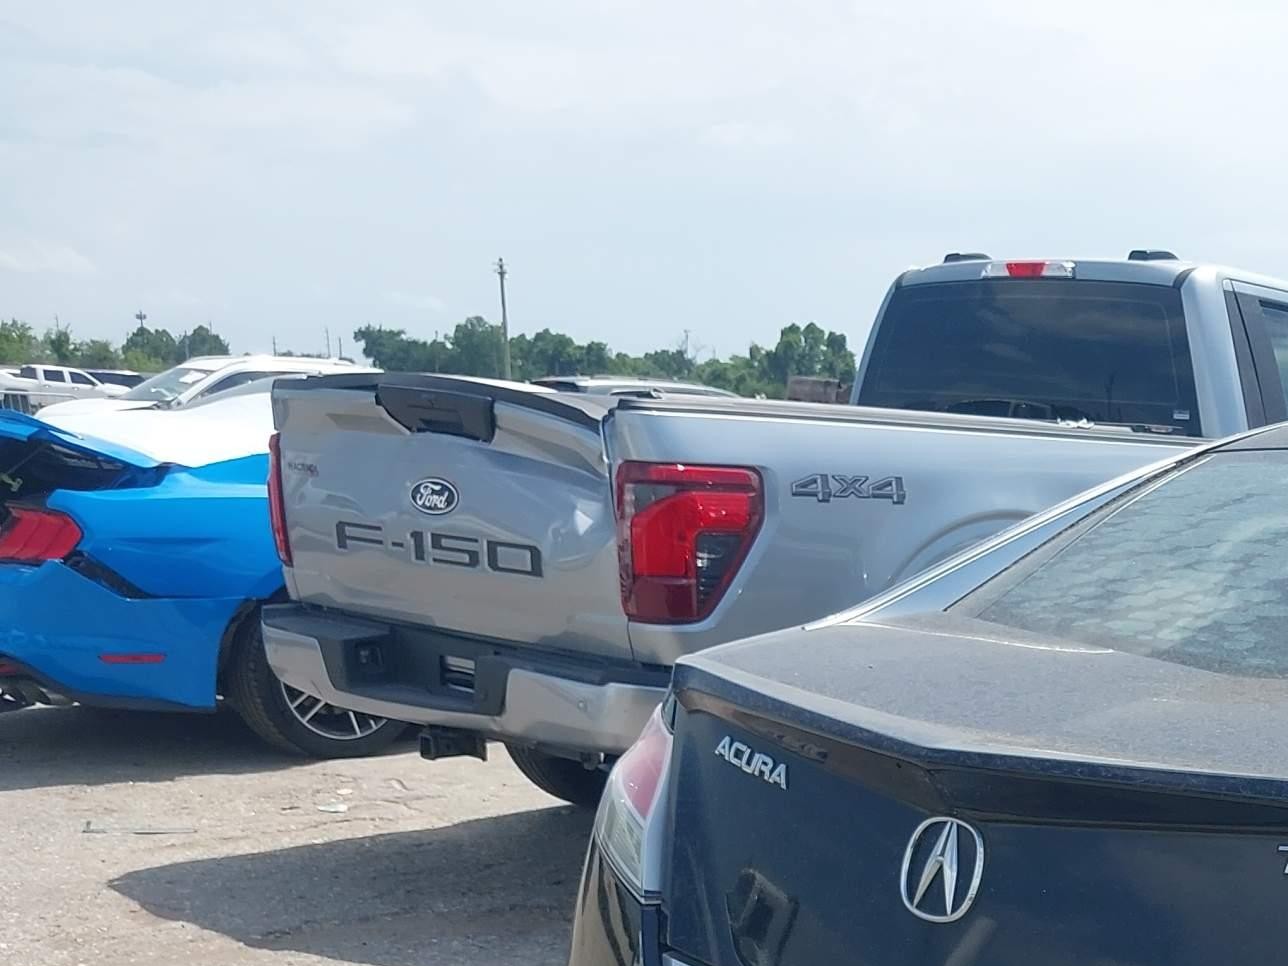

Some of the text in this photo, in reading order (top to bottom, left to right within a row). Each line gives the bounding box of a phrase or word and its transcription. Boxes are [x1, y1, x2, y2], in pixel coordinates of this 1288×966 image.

[416, 483, 449, 509] Ford
[335, 520, 544, 578] F-150
[714, 735, 787, 791] ACURA
